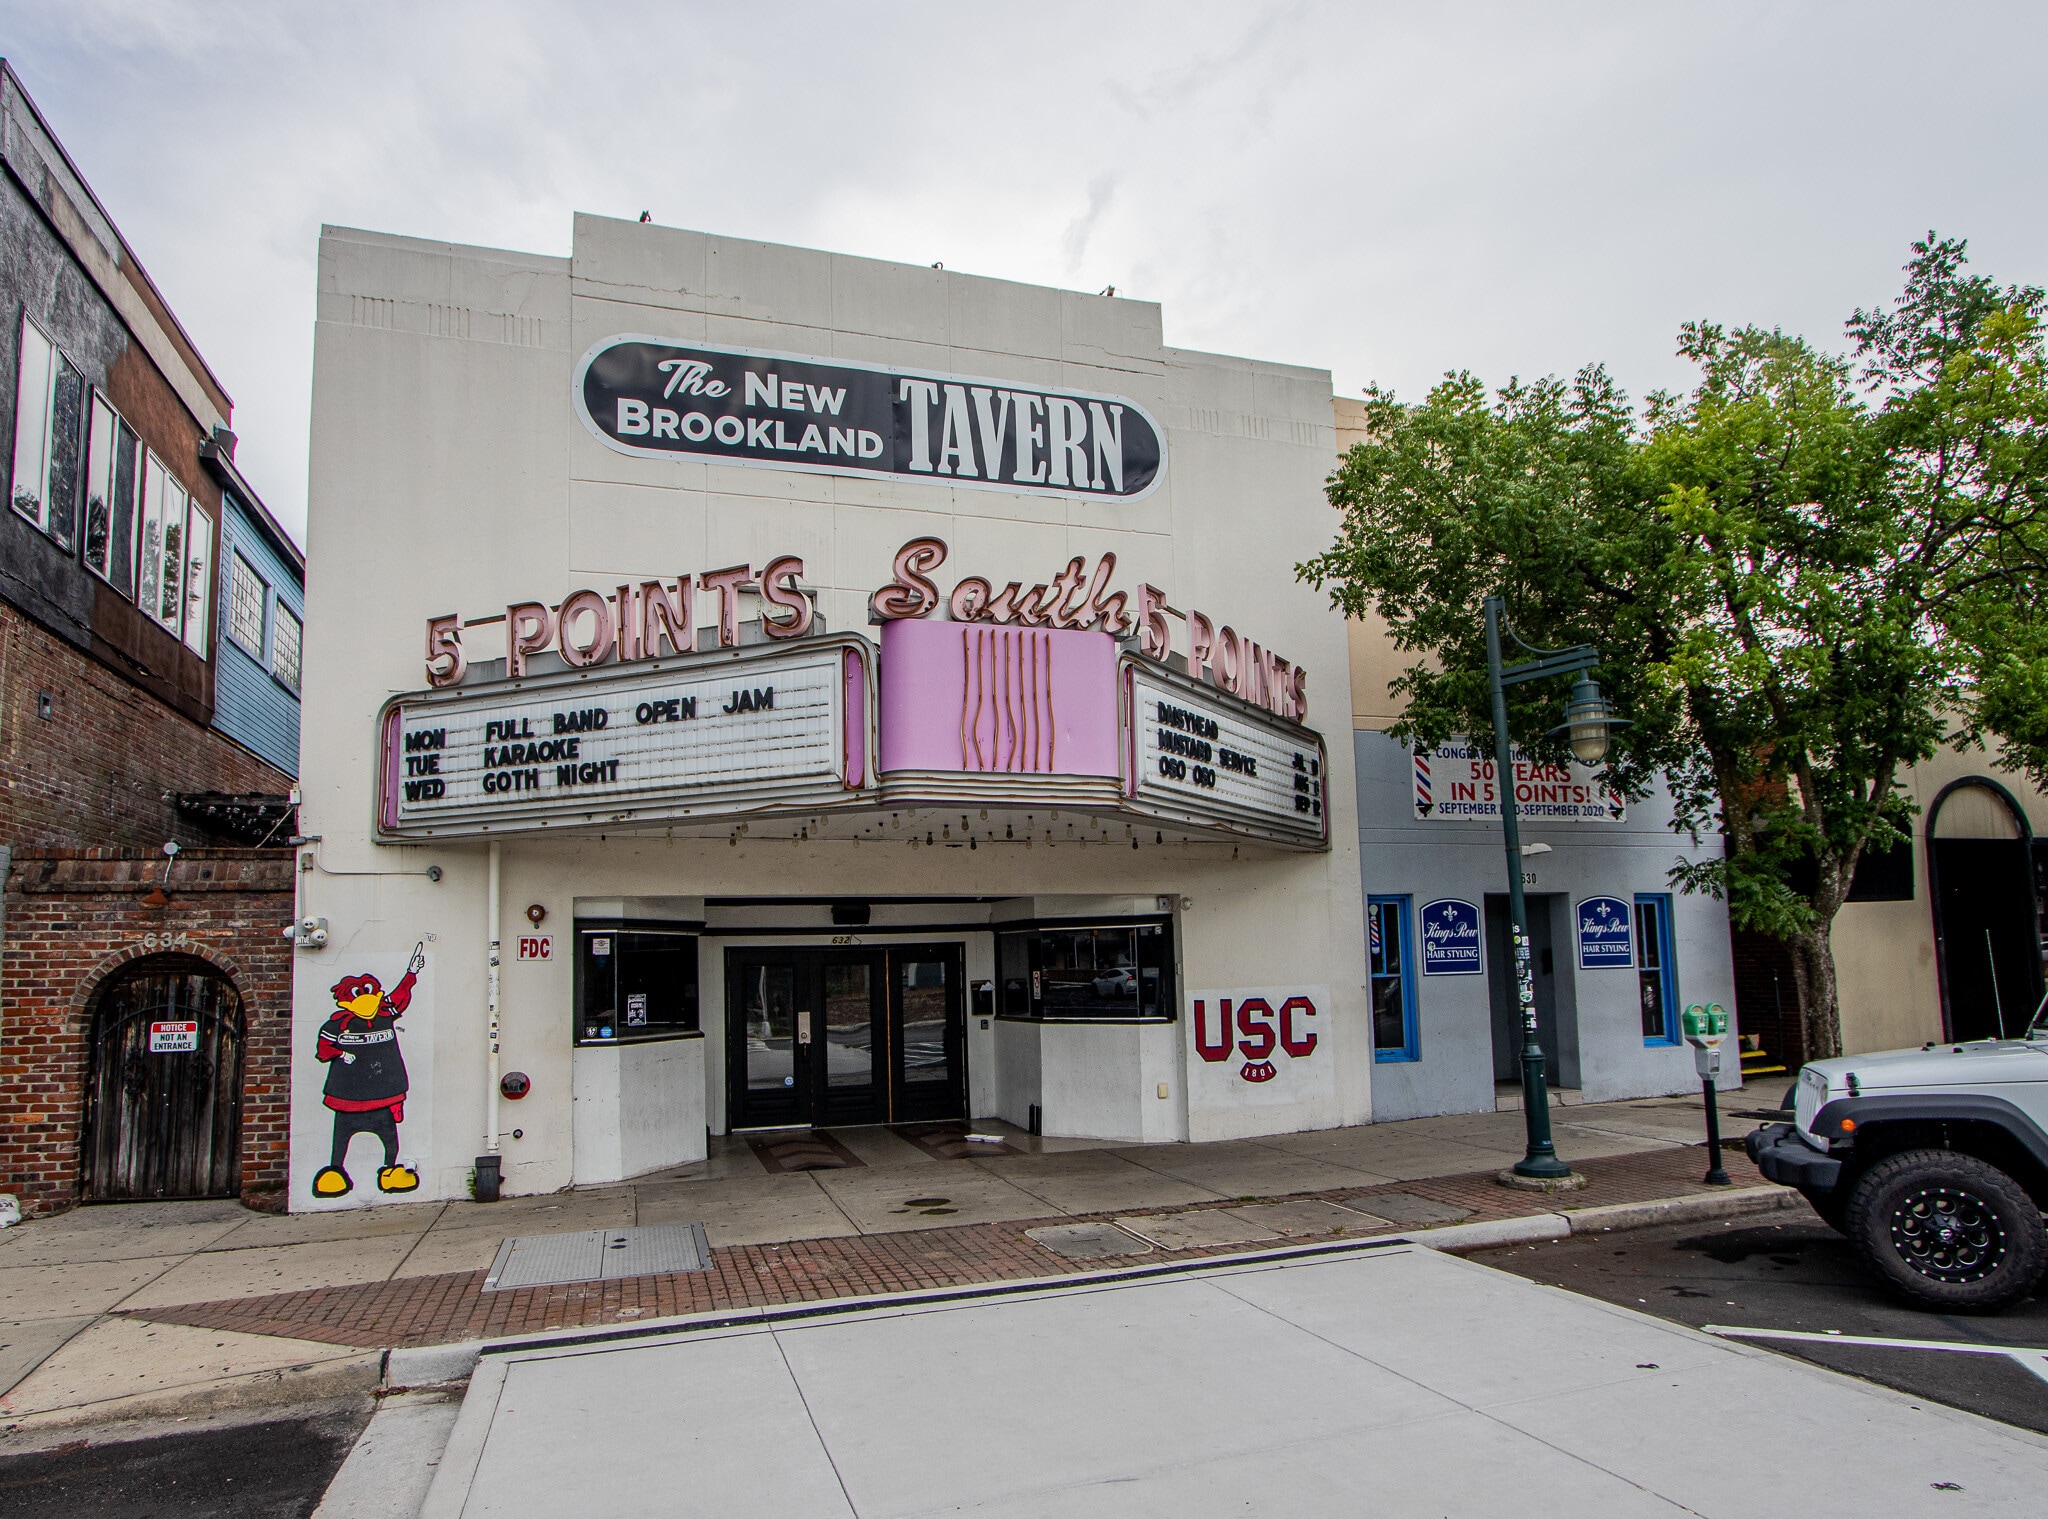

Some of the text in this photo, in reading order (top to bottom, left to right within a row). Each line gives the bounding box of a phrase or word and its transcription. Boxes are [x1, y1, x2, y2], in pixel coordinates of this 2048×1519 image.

[658, 359, 846, 416] The NEW
[616, 397, 883, 459] BROOKLAND
[900, 378, 1124, 492] TAVERN
[873, 536, 1132, 630] South
[426, 555, 812, 686] 5 POINTS
[1137, 583, 1307, 725] 5 POINTS
[405, 686, 773, 752] MON FULL BAND OPEN JAM
[1157, 701, 1219, 739] DAISYHEAD
[405, 738, 580, 777] TUE KARAOKE
[1158, 728, 1257, 776] MUSTARD SERVICE
[405, 759, 619, 800] WED GOTH NIGHT
[1159, 756, 1216, 788] OSO OSO
[1470, 762, 1571, 782] 50 EARS
[1451, 783, 1591, 803] IN 5 OINTS!
[1439, 803, 1497, 815] SEPTEMBER
[1582, 805, 1604, 817] 2020
[1424, 921, 1478, 943] Kings Row
[1580, 917, 1630, 939] Kings Row
[143, 932, 189, 948] 634
[520, 938, 550, 958] FDC
[832, 936, 850, 945] 632
[1583, 944, 1629, 953] HAIR STYLING
[1427, 949, 1478, 959] HAIR STYLING
[160, 1023, 188, 1032] NOTICE
[160, 1033, 188, 1042] NOT AN
[1194, 996, 1318, 1062] USC
[154, 1042, 193, 1051] ENTRANCE
[1244, 1065, 1273, 1078] 1801
